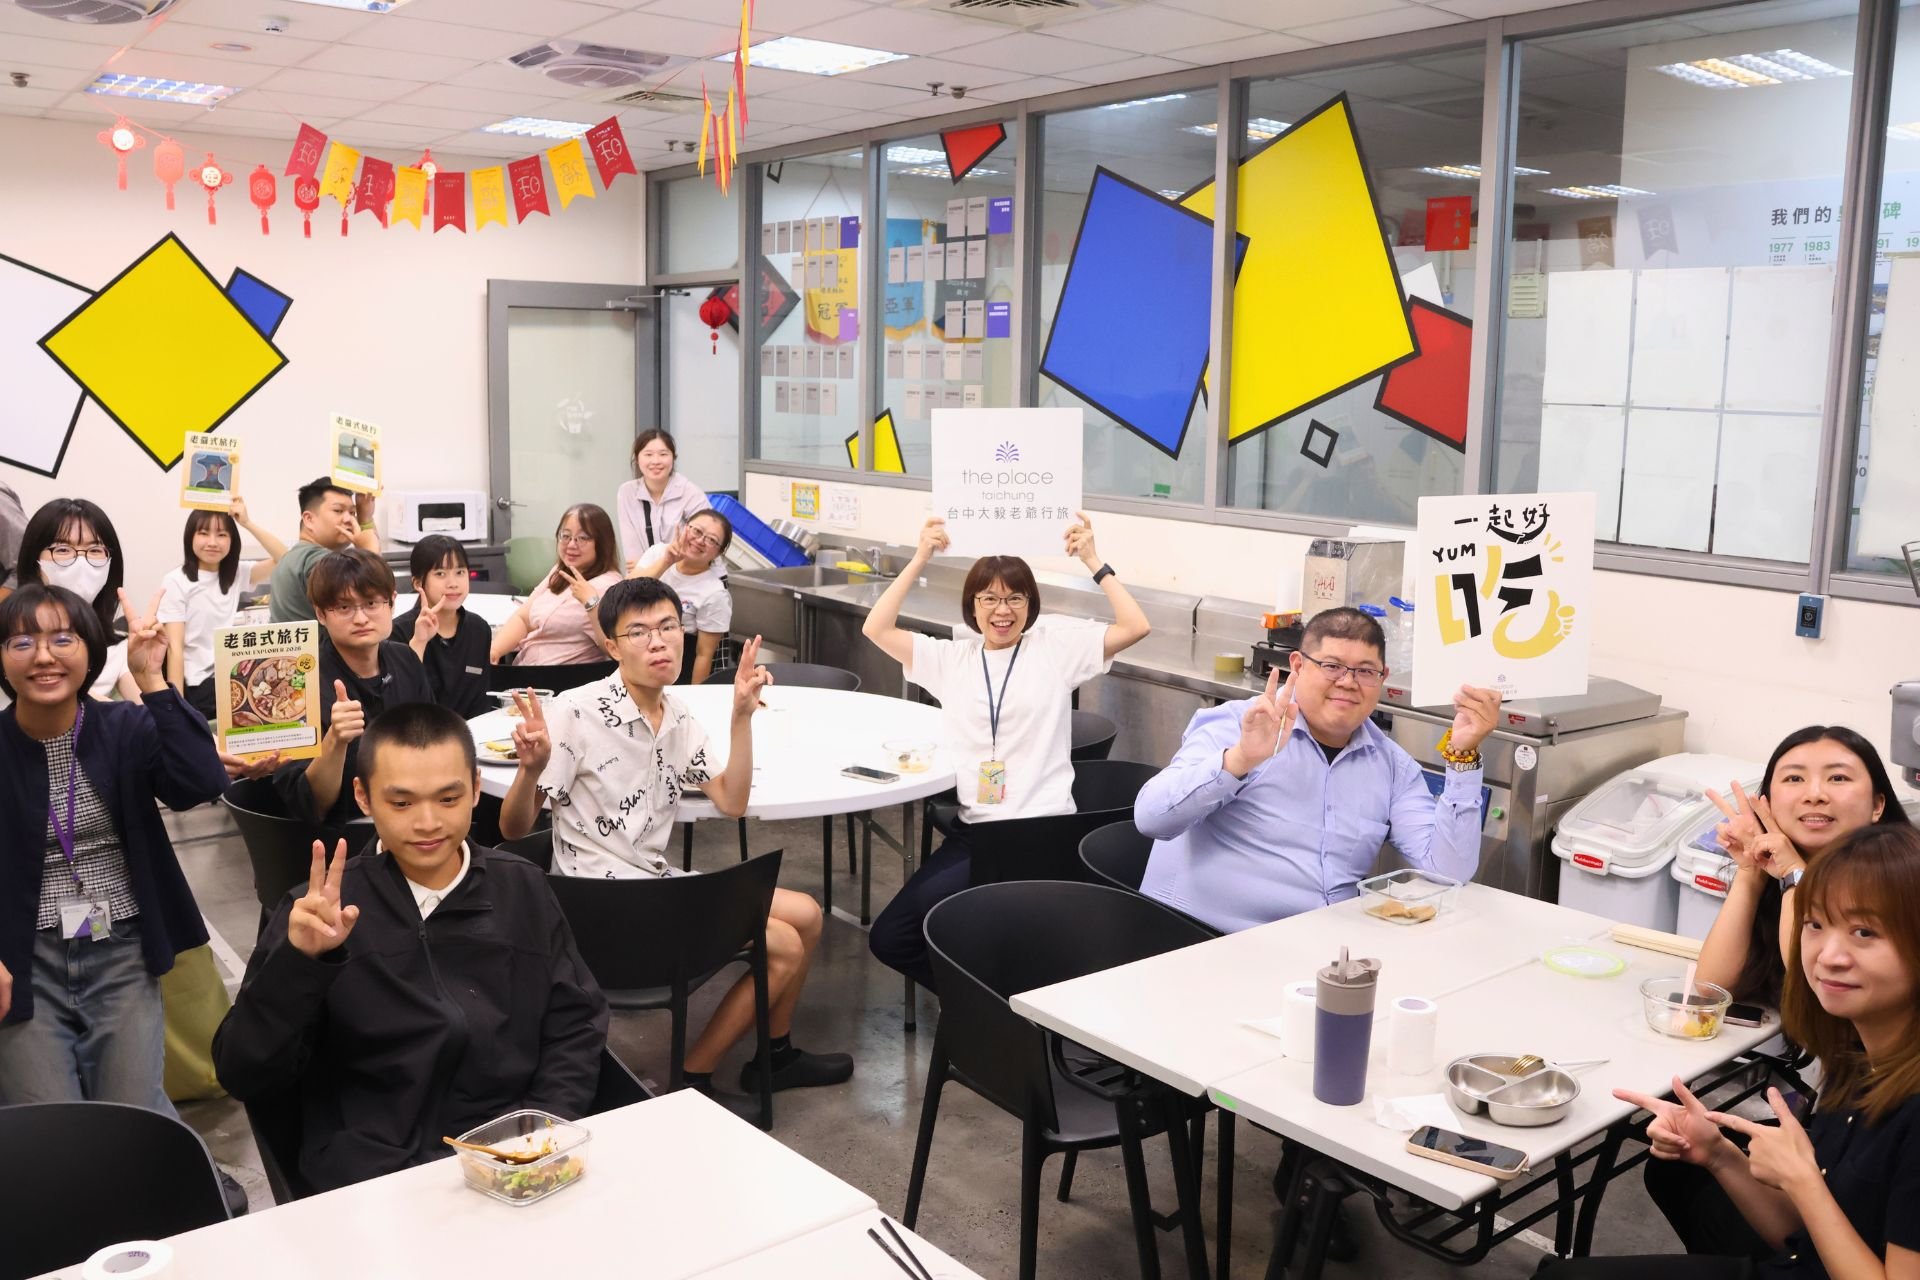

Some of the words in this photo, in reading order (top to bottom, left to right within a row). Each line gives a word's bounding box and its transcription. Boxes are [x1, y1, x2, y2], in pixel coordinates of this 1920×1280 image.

[1771, 201, 1902, 226] 我們的碑
[1769, 243, 1794, 253] 1977
[1804, 241, 1831, 252] 1983
[1876, 239, 1890, 249] 91
[190, 435, 237, 448] 老爺式旅行
[962, 469, 993, 485] the
[997, 469, 1054, 488] place
[982, 491, 1035, 502] taichung
[947, 507, 1069, 520] 台中大毅老爺行旅
[1454, 503, 1550, 544] 一起好
[1432, 543, 1476, 563] YUM
[224, 627, 309, 649] 老爺式旅行
